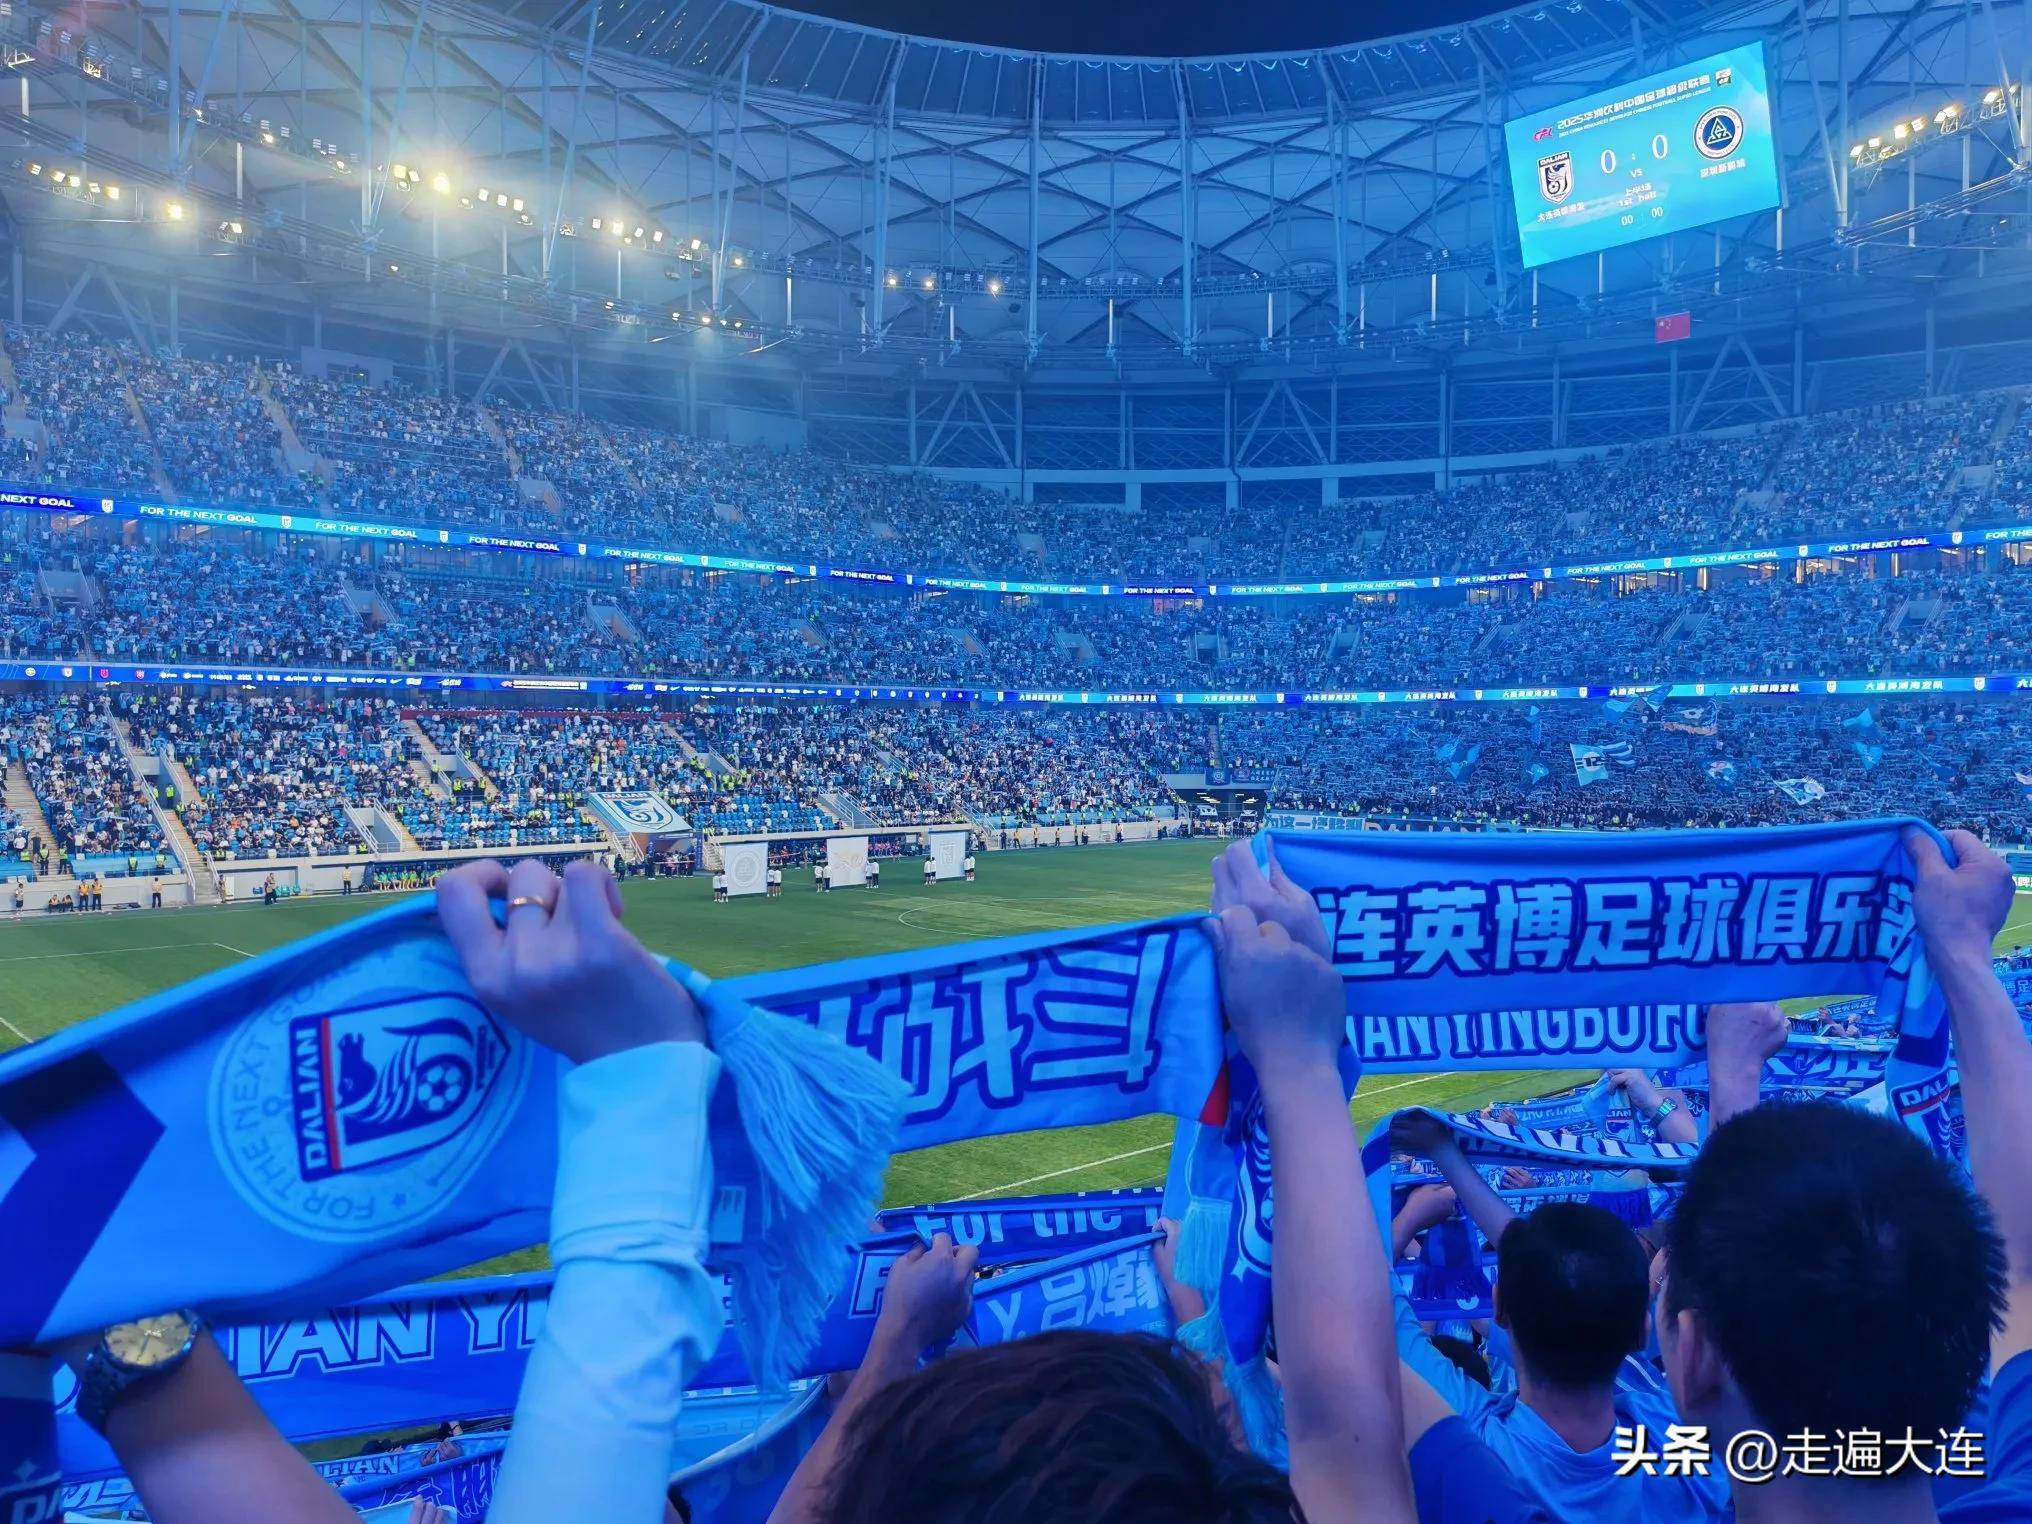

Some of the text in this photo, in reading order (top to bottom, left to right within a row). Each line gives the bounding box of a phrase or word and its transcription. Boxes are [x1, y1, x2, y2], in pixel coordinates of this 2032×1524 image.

[1600, 149, 1617, 174] 0
[1652, 134, 1668, 159] 0
[0, 493, 74, 507] NEXT GOAL
[139, 505, 258, 525] FOR THE NEXT GOAL
[314, 520, 417, 538] FOR THE NEXT GOAL
[1985, 527, 2032, 540] FOR THE
[468, 535, 560, 551] FOR THE NEXT GOAL
[1828, 537, 1929, 552] FOR THE NEXT GOAL
[604, 547, 684, 564] FOR THE NEXT GOAL
[1688, 549, 1777, 564] FOR THE NEXT GOAL
[830, 569, 894, 581] FOR THE NEXT GOAL
[1567, 562, 1646, 574] FOR THE NEXT GOAL
[1454, 571, 1528, 584] FOR THE NEXT GOAL
[1123, 586, 1138, 594] FOR
[294, 1026, 329, 1172] DALIAN
